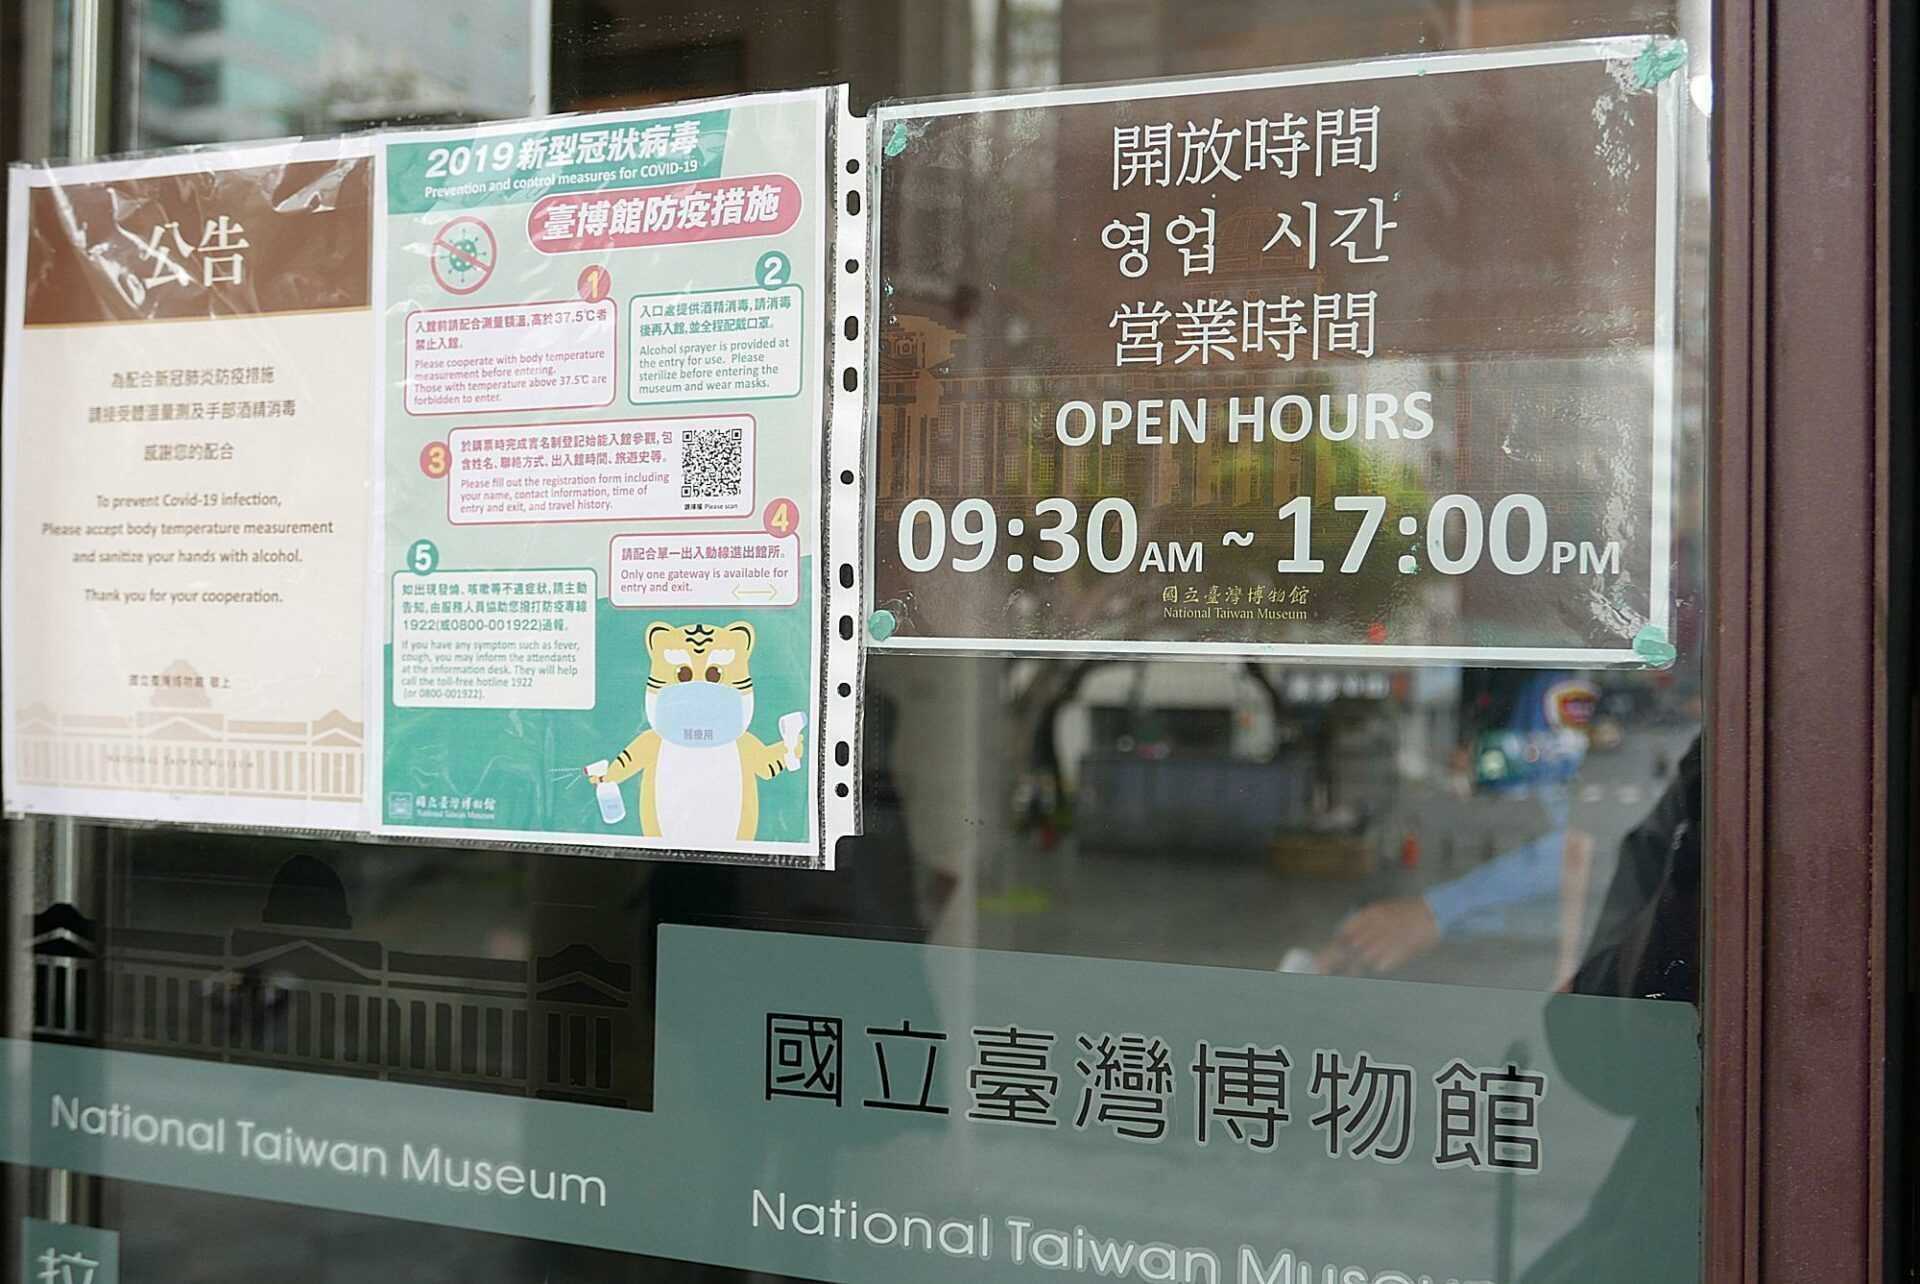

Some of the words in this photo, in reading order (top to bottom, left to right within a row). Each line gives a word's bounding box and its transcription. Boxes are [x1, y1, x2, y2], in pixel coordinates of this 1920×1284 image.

[425, 120, 700, 178] 2019新型冠狀病毒
[1112, 105, 1381, 191] 開放時間
[425, 181, 486, 198] Prevention
[489, 178, 511, 191] and
[514, 174, 556, 190] control
[558, 170, 616, 185] measures
[620, 168, 636, 180] for
[640, 159, 698, 178] COVID-19
[542, 184, 782, 240] 臺博館防疫措施
[1101, 207, 1216, 279] 영업
[1261, 197, 1398, 271] 시간
[145, 215, 251, 290] 公告
[763, 257, 782, 285] 2
[587, 270, 599, 299] 1
[1109, 290, 1378, 367] 営業時間
[640, 344, 676, 356] Alcohol
[680, 343, 716, 354] sprayer
[720, 341, 727, 350] is
[730, 338, 776, 351] provided
[778, 338, 789, 348] at
[415, 358, 445, 369] Please
[447, 357, 494, 370] cooperate
[496, 356, 517, 365] with
[520, 353, 543, 364] body
[546, 350, 605, 362] temperature
[640, 359, 656, 368] the
[658, 357, 684, 371] entry
[688, 355, 702, 365] for
[704, 356, 726, 364] use.
[731, 353, 765, 363] Please
[415, 370, 479, 381] measurement
[481, 368, 512, 377] before
[640, 369, 677, 381] sterilize
[680, 367, 712, 379] before
[715, 365, 759, 378] entering
[761, 364, 779, 374] the
[415, 384, 442, 393] Those
[445, 382, 465, 391] with
[468, 380, 527, 391] temperature
[529, 377, 557, 387] above
[592, 376, 607, 384] are
[640, 383, 681, 394] museum
[684, 380, 703, 391] and
[706, 380, 731, 390] wear
[735, 378, 770, 389] masks.
[414, 395, 460, 406] forbidden
[462, 395, 472, 403] to
[1054, 397, 1208, 447] OPEN
[1228, 390, 1435, 444] HOURS
[429, 446, 444, 474] 3
[460, 479, 490, 489] Please
[492, 477, 505, 488] fill
[506, 479, 522, 488] out
[524, 477, 540, 487] the
[542, 474, 596, 487] registration
[598, 473, 621, 483] form
[624, 472, 670, 484] including
[97, 495, 109, 508] To
[112, 496, 160, 510] prevent
[163, 493, 218, 506] Covid-19
[221, 492, 282, 507] infection,
[460, 492, 481, 501] your
[514, 489, 548, 499] contact
[613, 486, 635, 496] time
[637, 485, 648, 495] of
[460, 503, 484, 514] entry
[487, 501, 504, 512] and
[528, 500, 546, 511] and
[549, 499, 574, 510] travel
[770, 503, 789, 531] 4
[42, 523, 81, 535] Please
[85, 524, 123, 538] accept
[127, 522, 156, 538] body
[161, 523, 240, 536] temperature
[243, 521, 334, 534] measurement
[72, 549, 96, 562] and
[147, 553, 175, 565] your
[178, 549, 216, 562] hands
[220, 548, 248, 562] with
[252, 549, 303, 562] alcohol.
[414, 544, 430, 572] 5
[621, 569, 643, 581] Only
[647, 570, 665, 579] one
[668, 569, 710, 581] gateway
[713, 569, 721, 578] is
[723, 568, 770, 578] available
[773, 567, 788, 578] for
[85, 588, 120, 601] Thank
[124, 592, 145, 603] you
[149, 588, 166, 601] for
[170, 592, 198, 604] your
[621, 583, 646, 594] entry
[649, 582, 668, 592] and
[671, 582, 692, 592] exit.
[1162, 585, 1310, 605] 國立臺灣博物館
[1163, 607, 1211, 619] National
[1214, 608, 1253, 619] Taiwan
[1257, 608, 1307, 620] Museum
[411, 642, 429, 651] you
[431, 641, 452, 650] have
[455, 642, 470, 651] any
[473, 642, 517, 651] symptom
[519, 641, 540, 650] such
[542, 642, 552, 650] as
[435, 655, 452, 664] you
[454, 654, 473, 663] may
[476, 653, 506, 662] inform
[509, 653, 524, 662] the
[527, 653, 576, 662] attendants
[401, 666, 411, 674] at
[413, 665, 429, 674] the
[431, 665, 485, 674] information
[514, 666, 536, 675] They
[538, 666, 554, 674] will
[557, 666, 578, 676] help
[401, 678, 417, 686] call
[419, 678, 435, 686] the
[437, 678, 474, 686] toll-free
[476, 678, 508, 687] hotline
[511, 678, 533, 687] 1922
[765, 1011, 1545, 1172] 國立臺灣博物館
[50, 1093, 225, 1156] National
[237, 1119, 388, 1179] Taiwan
[400, 1141, 608, 1208] Museum
[751, 1188, 990, 1258] National
[1008, 1220, 1217, 1284] Taiwan
